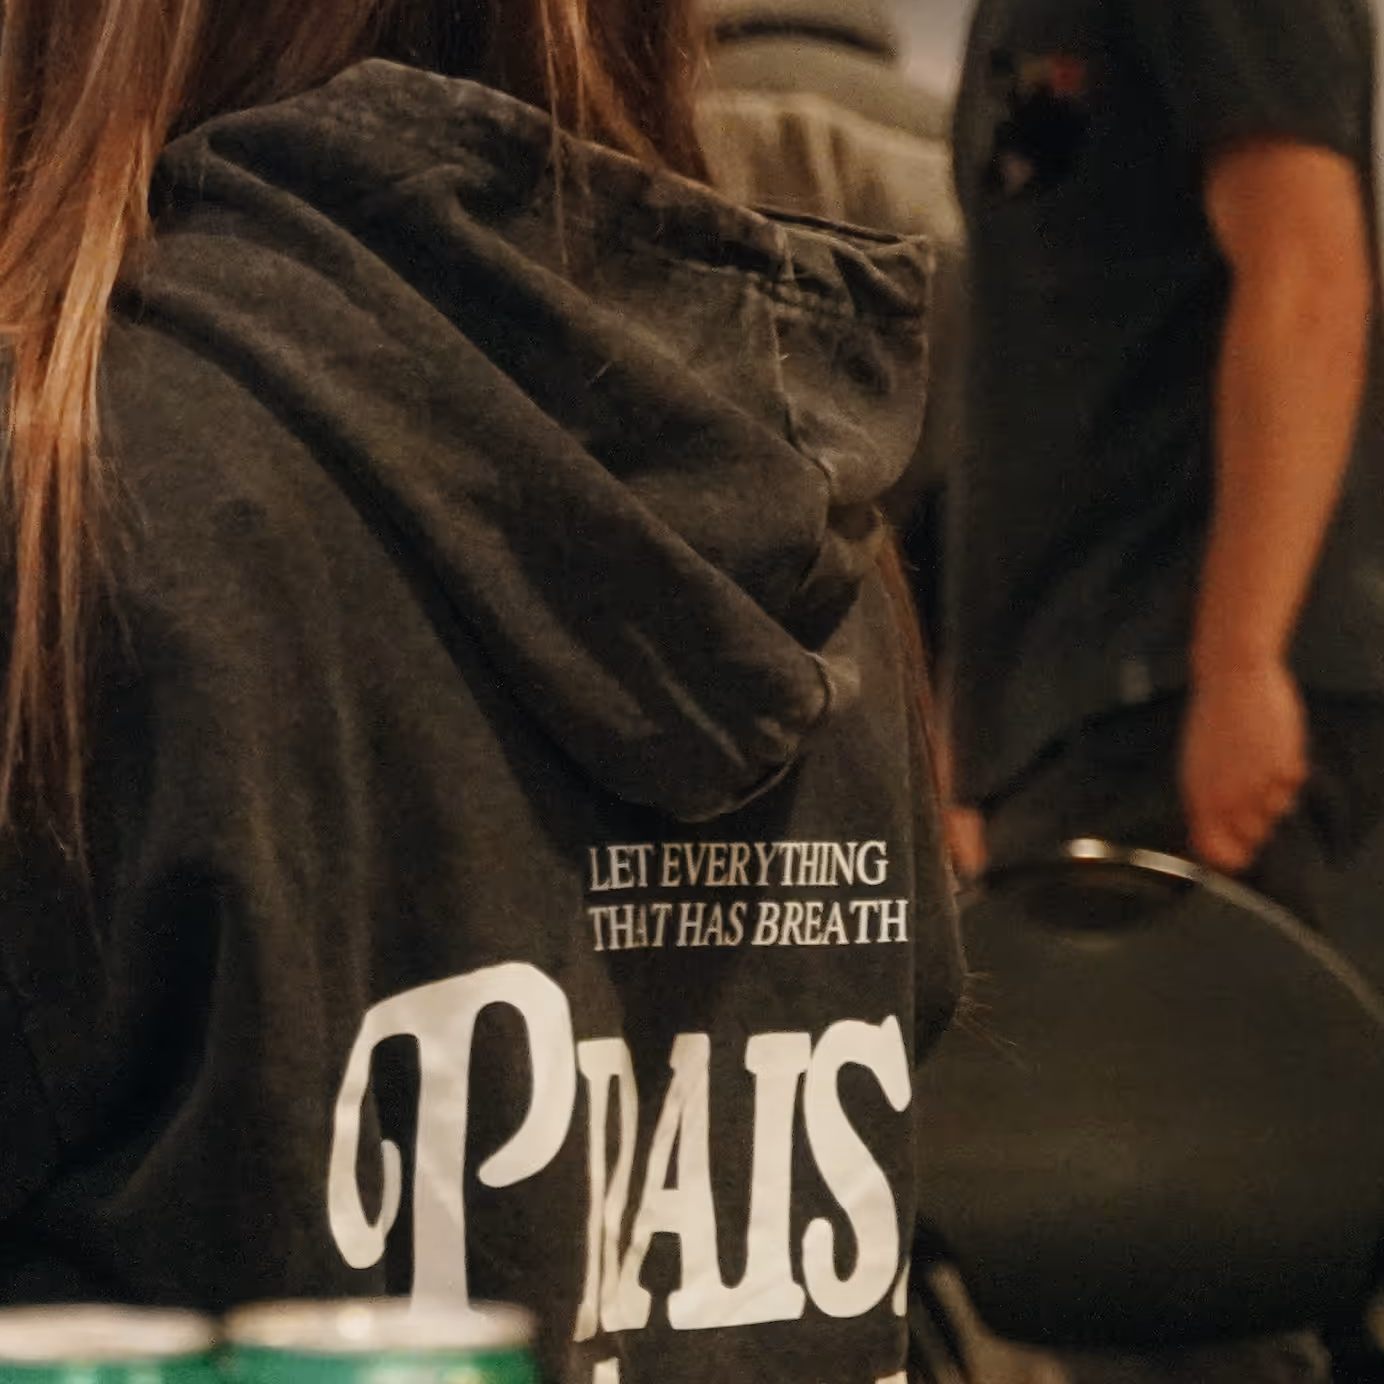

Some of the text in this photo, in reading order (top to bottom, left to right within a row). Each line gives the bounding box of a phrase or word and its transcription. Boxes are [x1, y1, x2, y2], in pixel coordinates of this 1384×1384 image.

[588, 839, 890, 892] LET EVERYTHING
[587, 898, 910, 952] THAT HAS BREATH
[327, 961, 912, 1343] PRAIS
